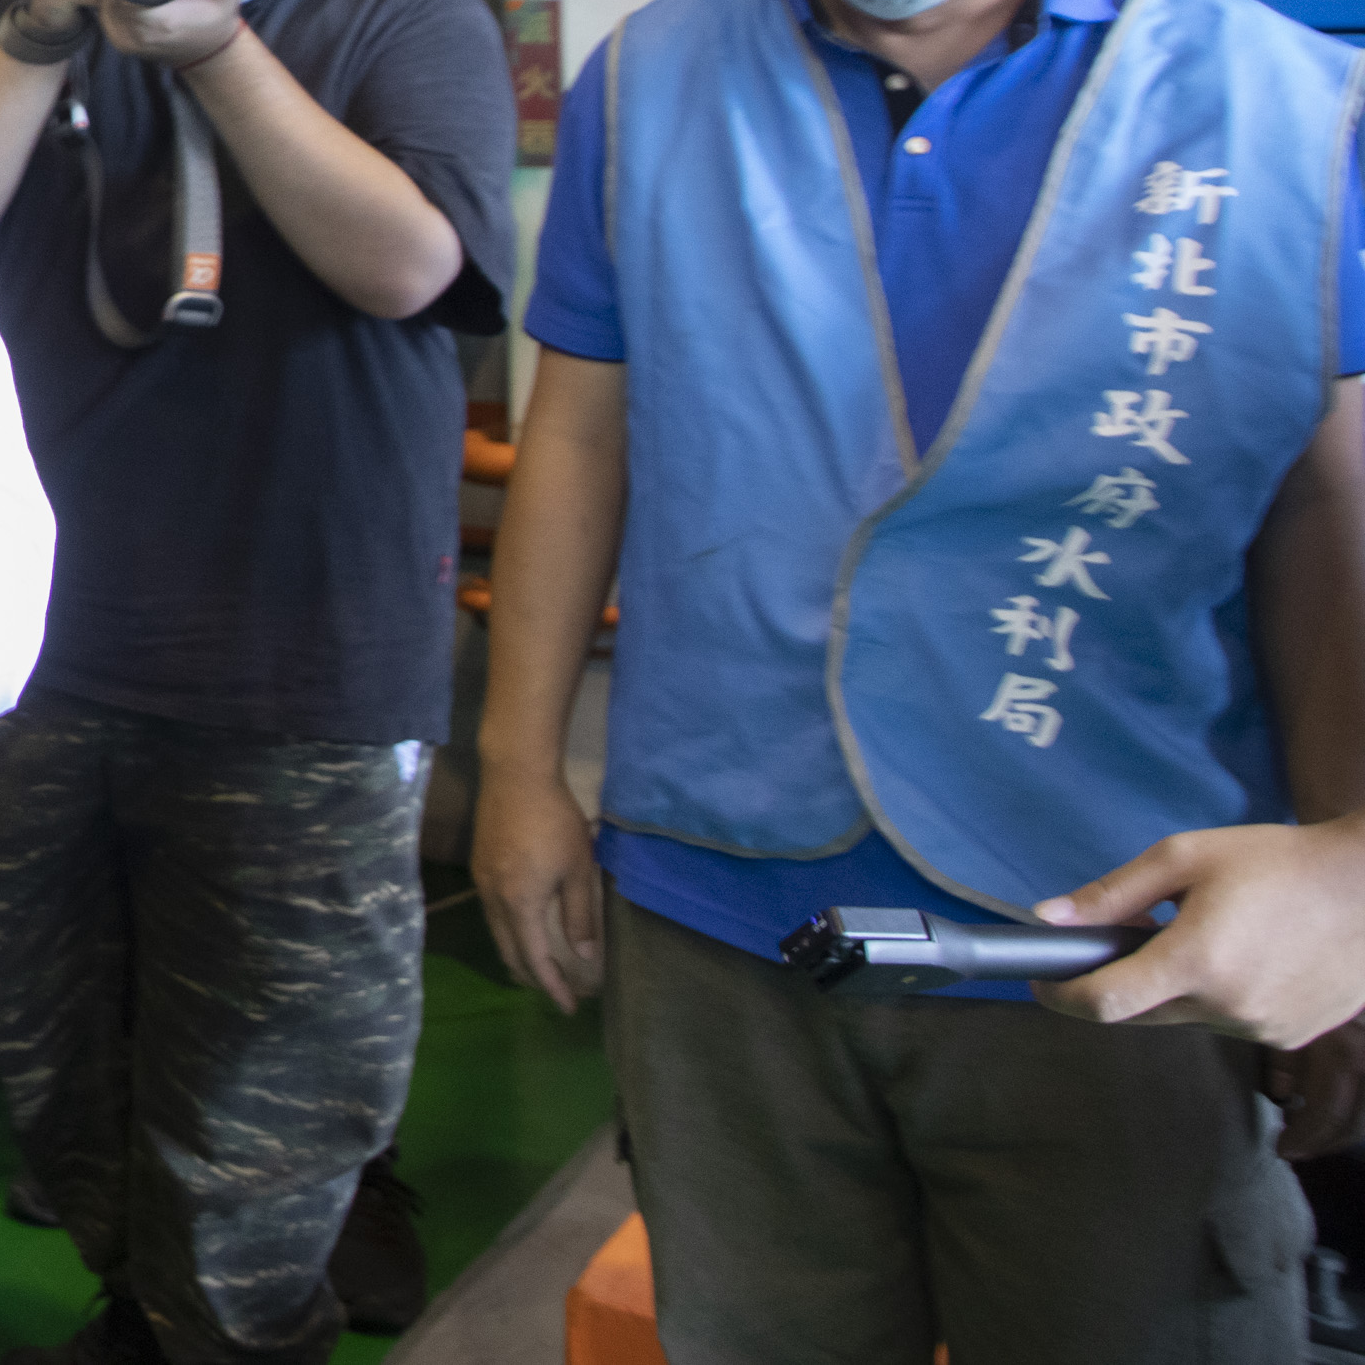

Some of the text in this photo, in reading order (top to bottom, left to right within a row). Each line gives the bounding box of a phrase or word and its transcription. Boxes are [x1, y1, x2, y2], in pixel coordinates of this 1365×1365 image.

[979, 161, 1239, 749] 新北市政府水利局
